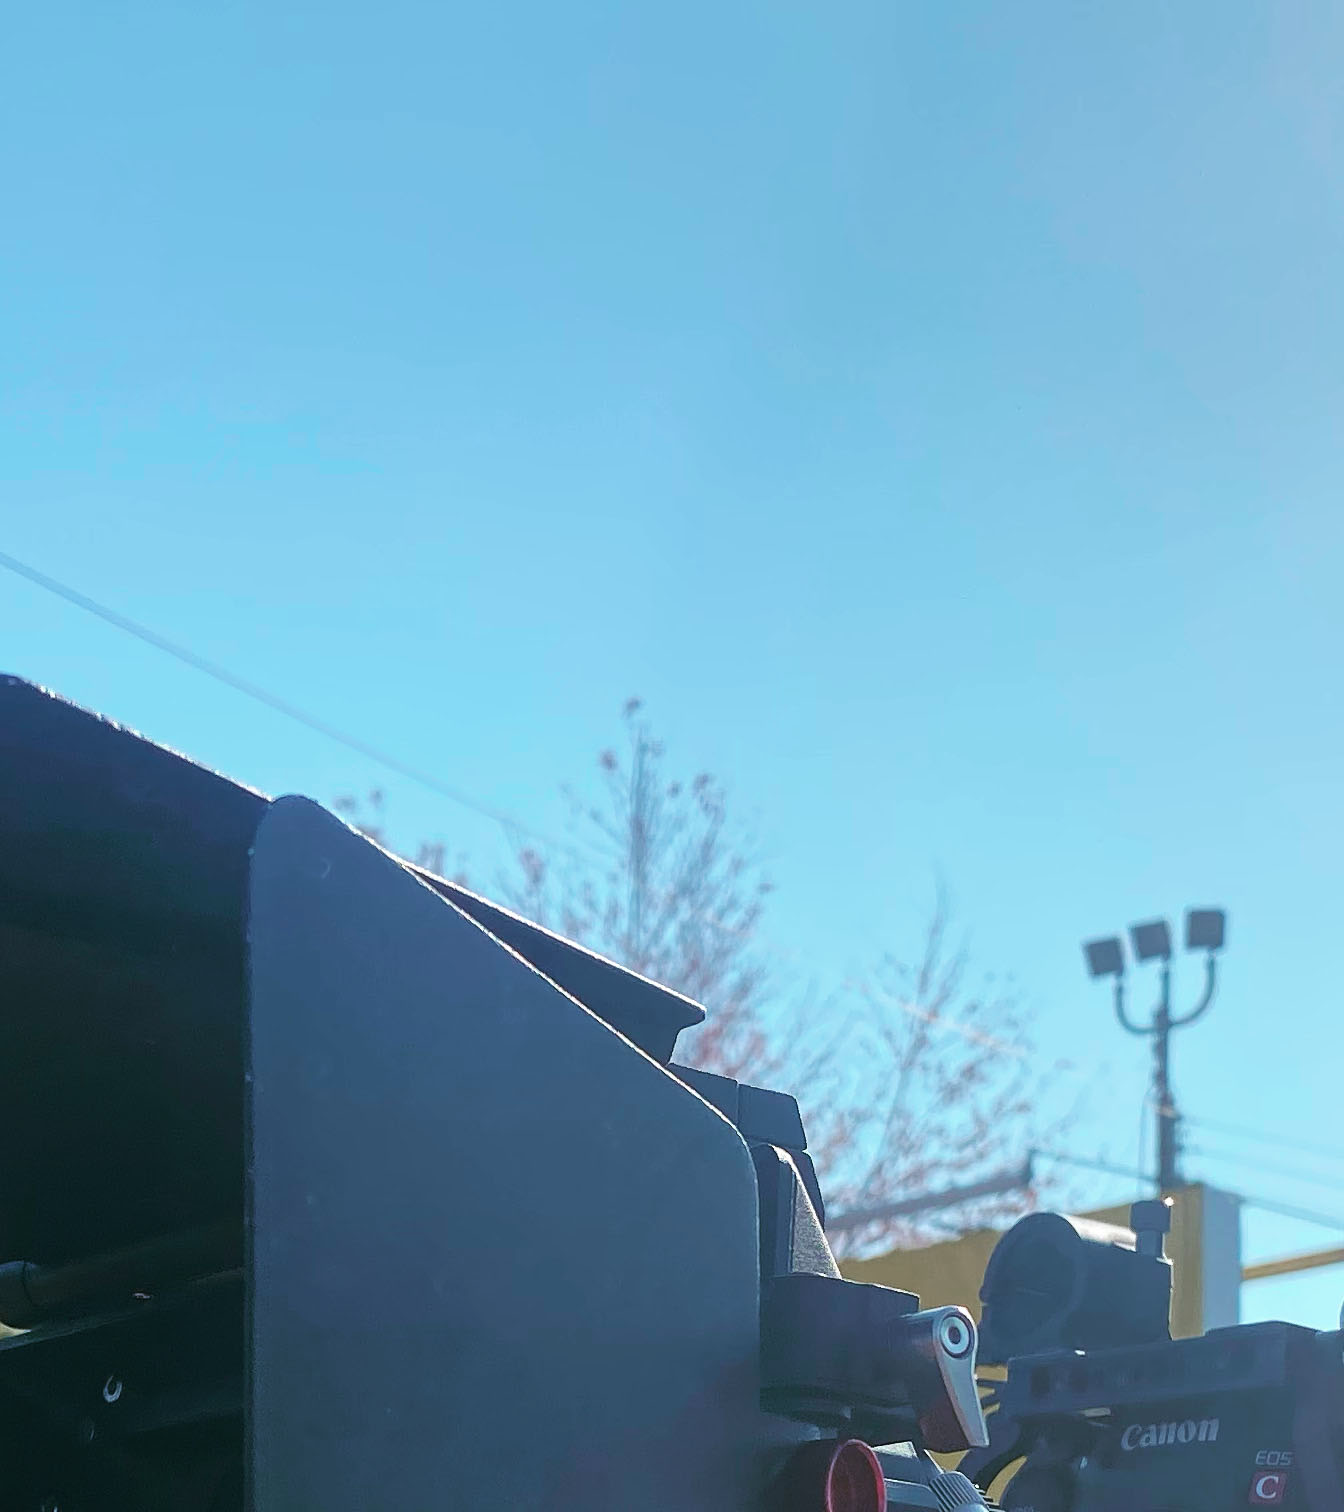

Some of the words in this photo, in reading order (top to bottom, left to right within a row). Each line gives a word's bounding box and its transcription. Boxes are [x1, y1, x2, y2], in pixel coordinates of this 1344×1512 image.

[1120, 1417, 1220, 1451] Canon
[1255, 1450, 1294, 1466] EOS
[1255, 1475, 1279, 1499] C
